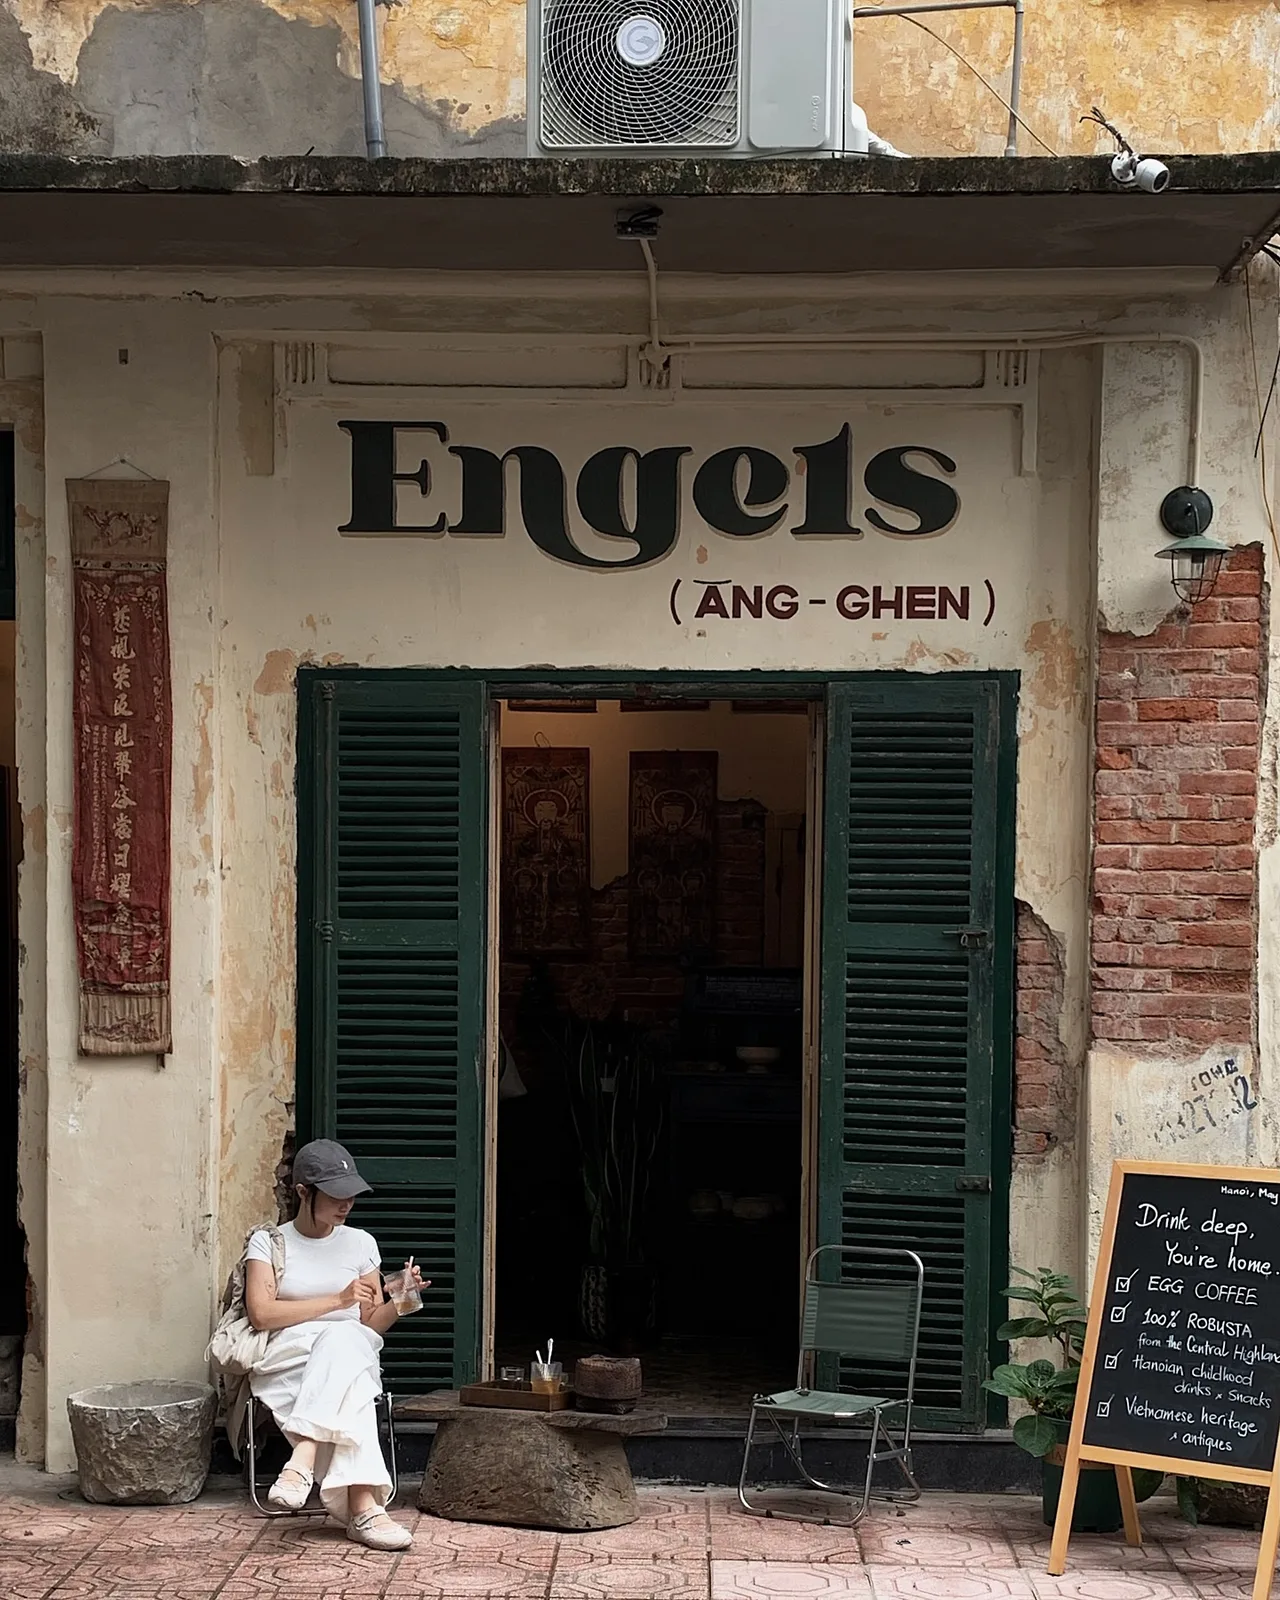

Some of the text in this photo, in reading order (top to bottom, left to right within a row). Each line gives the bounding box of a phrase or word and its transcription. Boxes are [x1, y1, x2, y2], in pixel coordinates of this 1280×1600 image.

[338, 420, 960, 568] Engels
[1220, 1185, 1279, 1206] Hanoi, May
[1135, 1203, 1255, 1246] Drink deep,
[1165, 1240, 1280, 1274] You're home.
[1147, 1275, 1258, 1306] EGG COFFEE
[1141, 1307, 1252, 1339] 100% ROBUSTA
[1137, 1332, 1162, 1349] from
[1165, 1335, 1183, 1351] the
[1186, 1335, 1230, 1357] Central
[1132, 1354, 1254, 1387] Hanoian childhood
[1174, 1380, 1212, 1397] drinks
[1125, 1395, 1258, 1437] Vietnamese heritage
[1182, 1430, 1233, 1457] antiques
